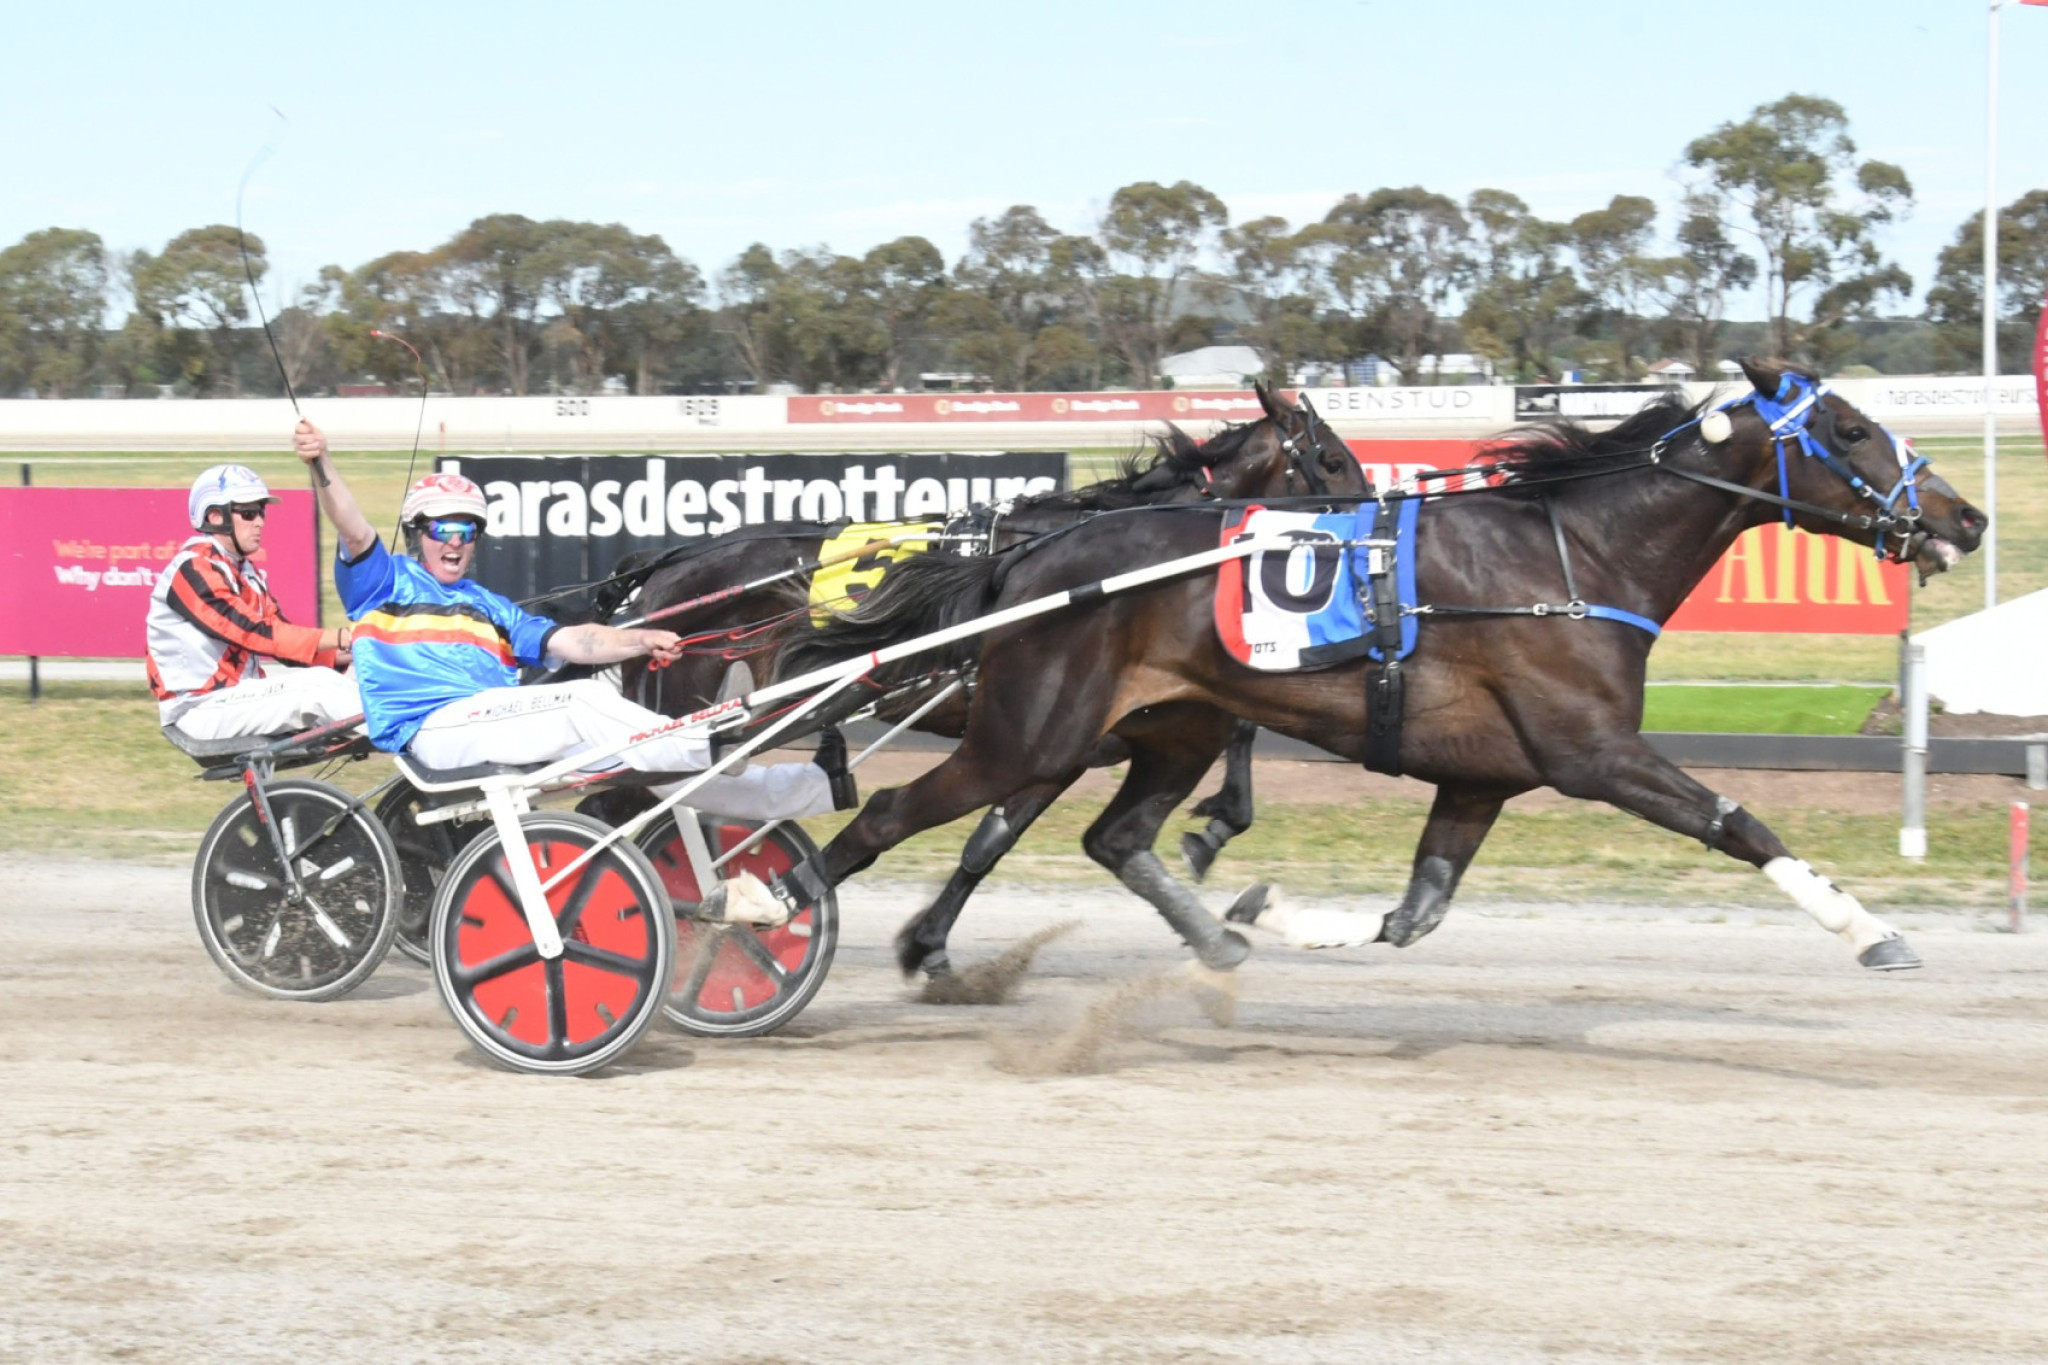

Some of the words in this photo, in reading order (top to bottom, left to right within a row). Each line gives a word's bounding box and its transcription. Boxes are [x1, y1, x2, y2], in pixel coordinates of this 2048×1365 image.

[1326, 390, 1474, 410] BENSTUD
[441, 458, 1056, 537] arasdestrotteur
[109, 541, 152, 564] part
[54, 566, 101, 591] Why
[102, 566, 153, 586] don't
[690, 698, 745, 723] BELLMA
